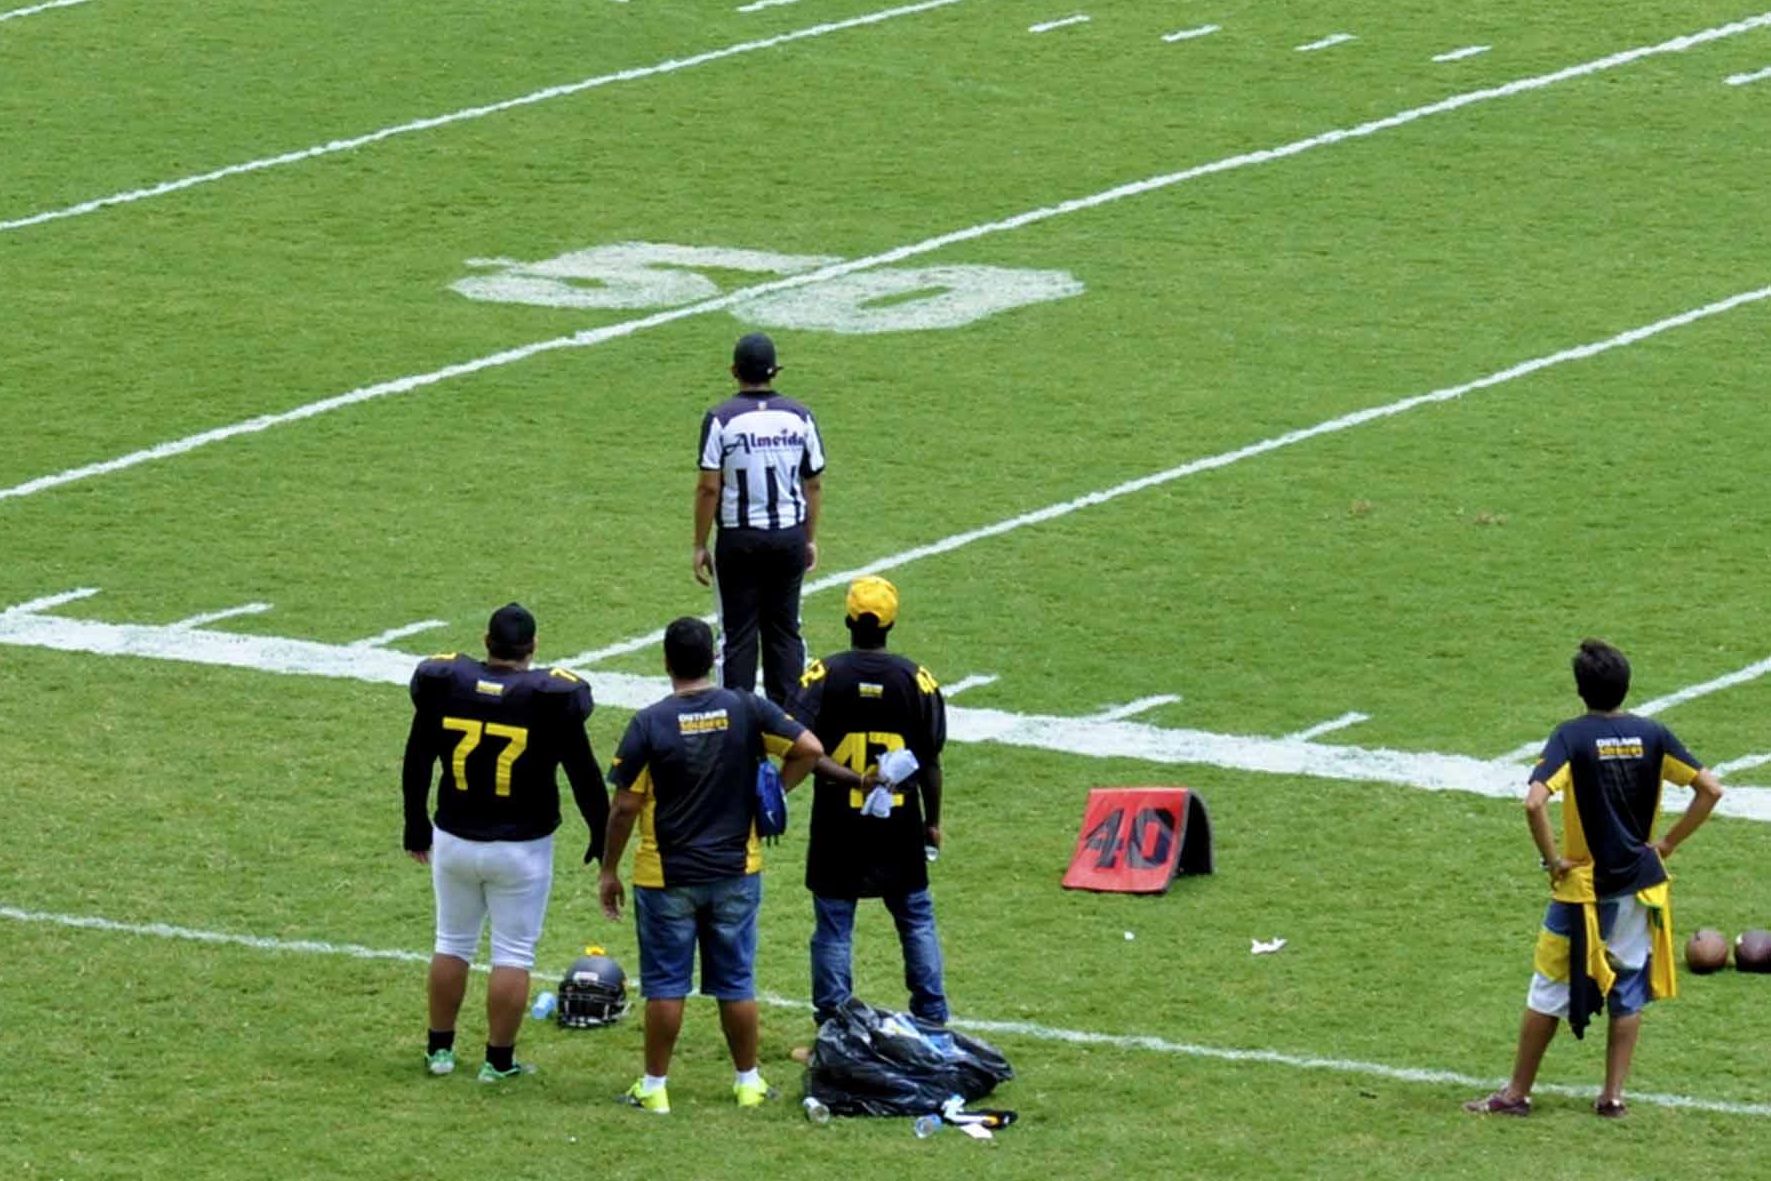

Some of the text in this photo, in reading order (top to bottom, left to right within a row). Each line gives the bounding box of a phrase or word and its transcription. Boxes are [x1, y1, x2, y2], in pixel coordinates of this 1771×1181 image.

[444, 240, 1086, 334] 50
[441, 716, 529, 797] 77
[1084, 807, 1177, 869] 40
